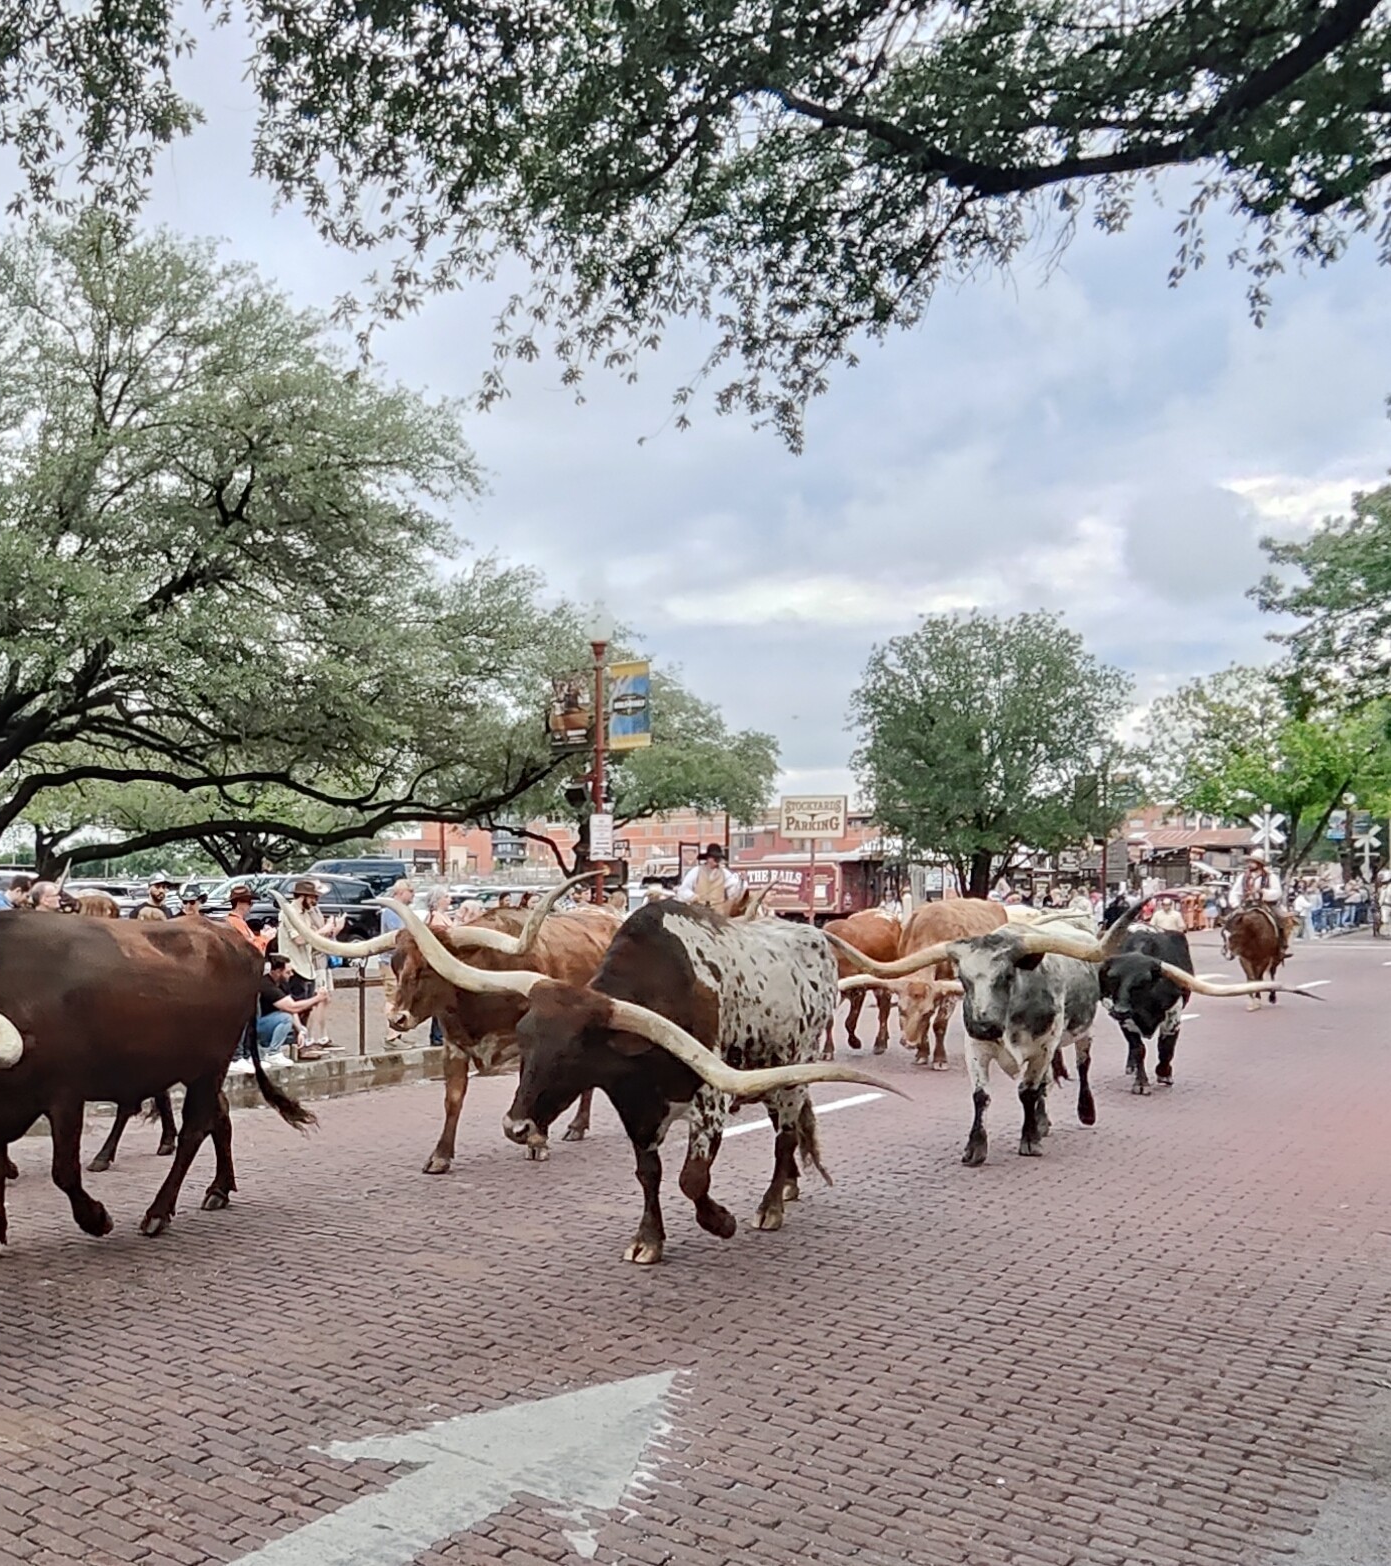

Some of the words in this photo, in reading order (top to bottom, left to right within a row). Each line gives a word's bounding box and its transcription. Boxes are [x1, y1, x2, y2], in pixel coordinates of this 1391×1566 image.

[784, 800, 842, 814] STOCKYARDS
[785, 815, 840, 831] PARKING
[747, 870, 769, 883] THE
[770, 870, 803, 885] RAILS
